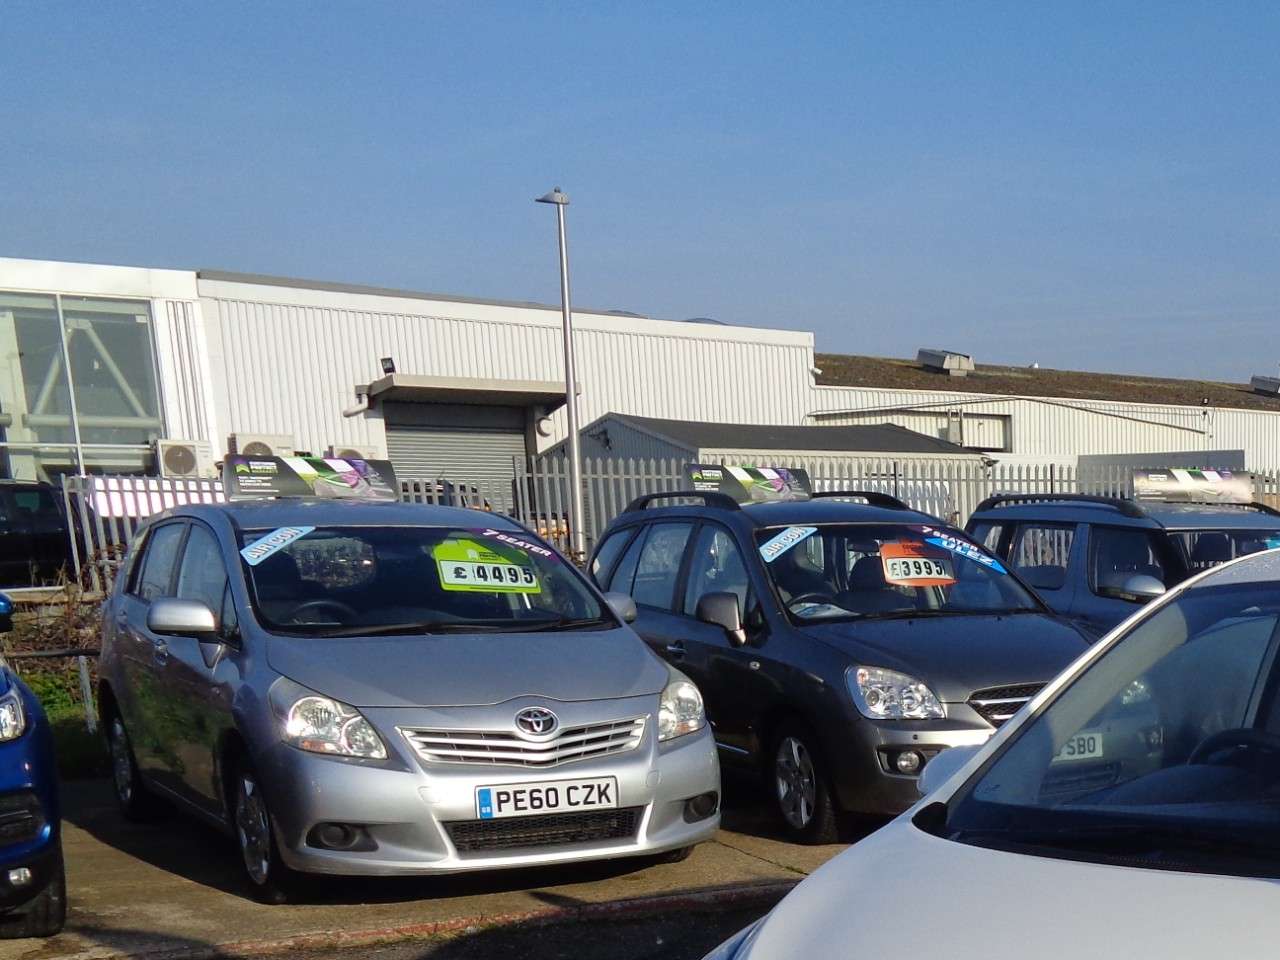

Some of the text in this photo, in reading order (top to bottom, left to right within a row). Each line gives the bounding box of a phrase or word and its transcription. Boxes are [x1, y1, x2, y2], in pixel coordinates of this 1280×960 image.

[496, 534, 552, 557] SEATER
[495, 783, 612, 813] PE60 CZK
